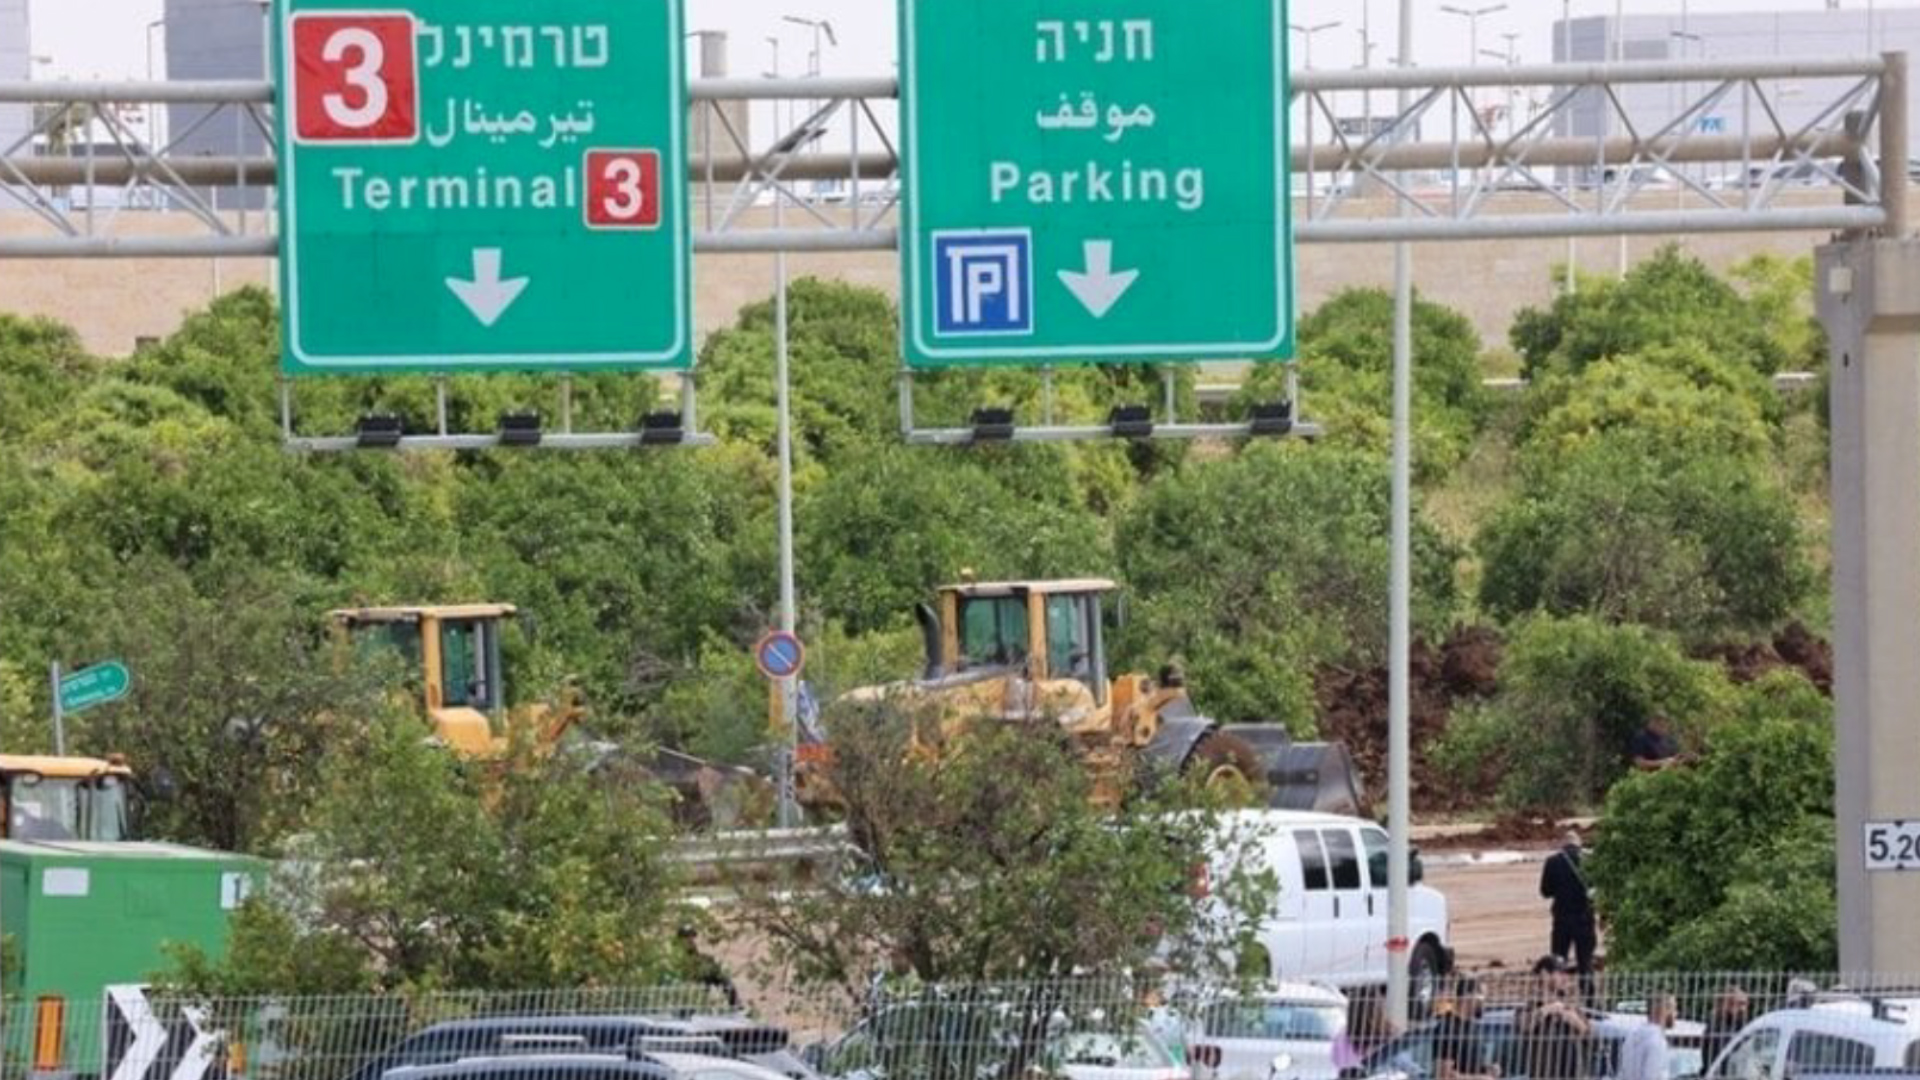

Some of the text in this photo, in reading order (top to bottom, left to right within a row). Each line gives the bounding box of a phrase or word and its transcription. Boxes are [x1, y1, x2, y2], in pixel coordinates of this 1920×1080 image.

[415, 19, 609, 68] טרמינל
[1036, 19, 1153, 62] חניה
[322, 27, 389, 128] 3
[425, 98, 596, 147] تيرمينال
[1036, 91, 1156, 142] موقف
[332, 158, 643, 219] Terminal 3
[990, 161, 1204, 210] Parking
